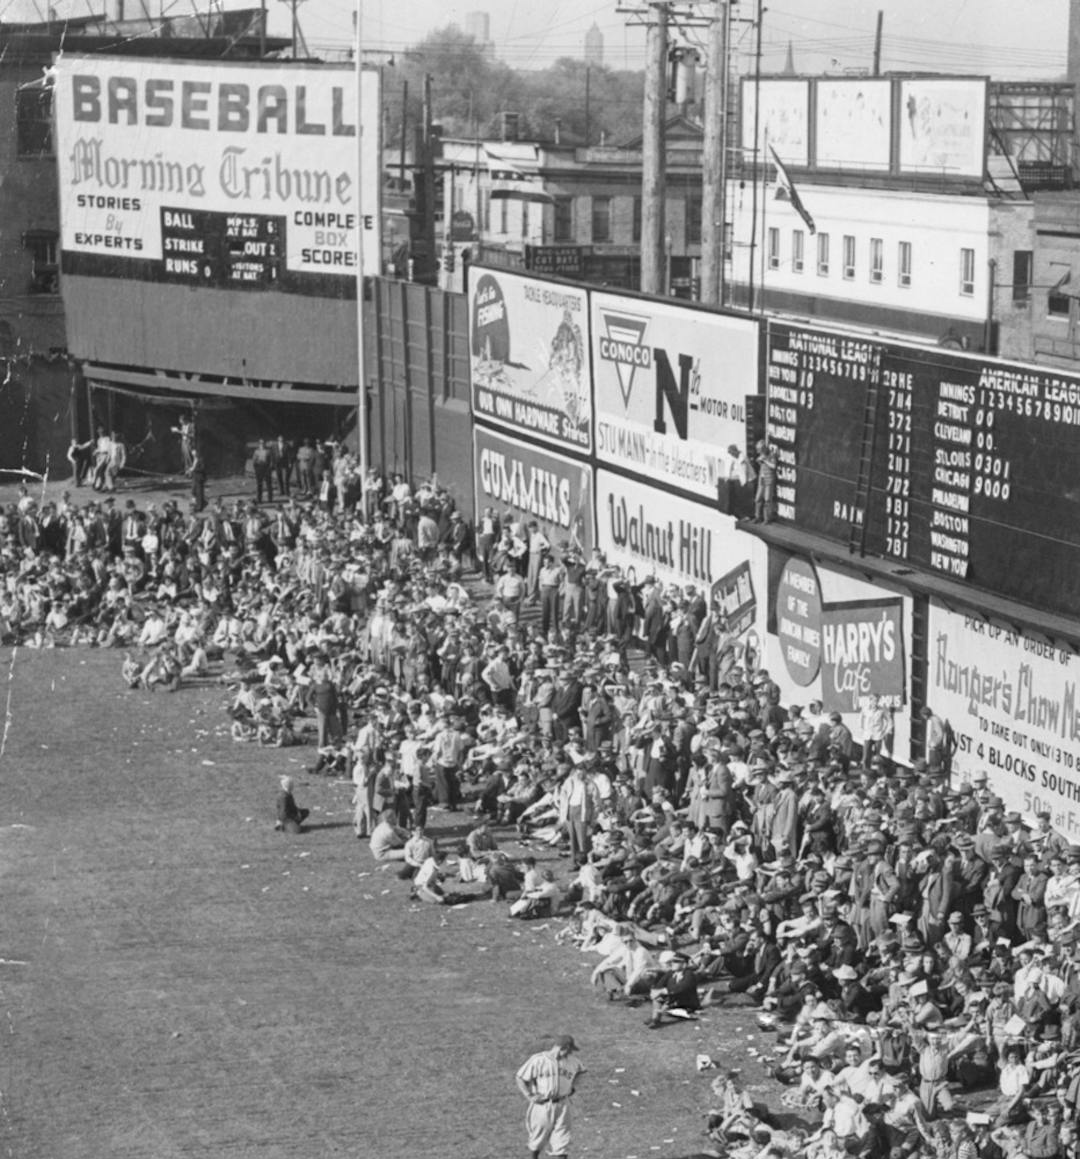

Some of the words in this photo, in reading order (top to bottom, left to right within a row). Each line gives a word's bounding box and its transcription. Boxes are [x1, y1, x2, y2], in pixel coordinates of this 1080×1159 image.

[72, 74, 362, 137] BASEBALL
[69, 136, 206, 198] Morning
[219, 145, 352, 206] Tribune
[77, 194, 141, 211] STORIES
[105, 213, 124, 235] By
[164, 211, 195, 229] BALL
[75, 232, 143, 251] EXPERTS
[164, 238, 204, 254] STRIKE
[315, 230, 348, 247] BOX
[166, 258, 198, 275] RUNS
[601, 341, 650, 366] CONOCO
[789, 331, 838, 358] NATIONAL
[939, 381, 976, 405] INNINGS
[979, 367, 1039, 397] AMERICAN
[700, 397, 728, 419] MOTOR
[731, 403, 745, 423] OIL
[481, 447, 570, 528] CUMMINS
[833, 500, 864, 524] RAIN
[608, 492, 675, 568] Walnut
[679, 519, 712, 584] Hill
[823, 610, 895, 664] HARRY'S
[964, 614, 985, 635] PICK
[988, 623, 1002, 640] UP
[1004, 629, 1019, 648] AN
[1023, 635, 1055, 661] ORDER
[1059, 649, 1071, 667] OF
[1014, 661, 1059, 733] Chow
[979, 716, 988, 732] TO
[991, 720, 1010, 742] TAKE
[1012, 730, 1028, 749] OUT
[1031, 738, 1051, 759] ONLY
[1063, 751, 1073, 769] TO
[976, 742, 984, 760] 4
[988, 746, 1036, 782] BLOCKS
